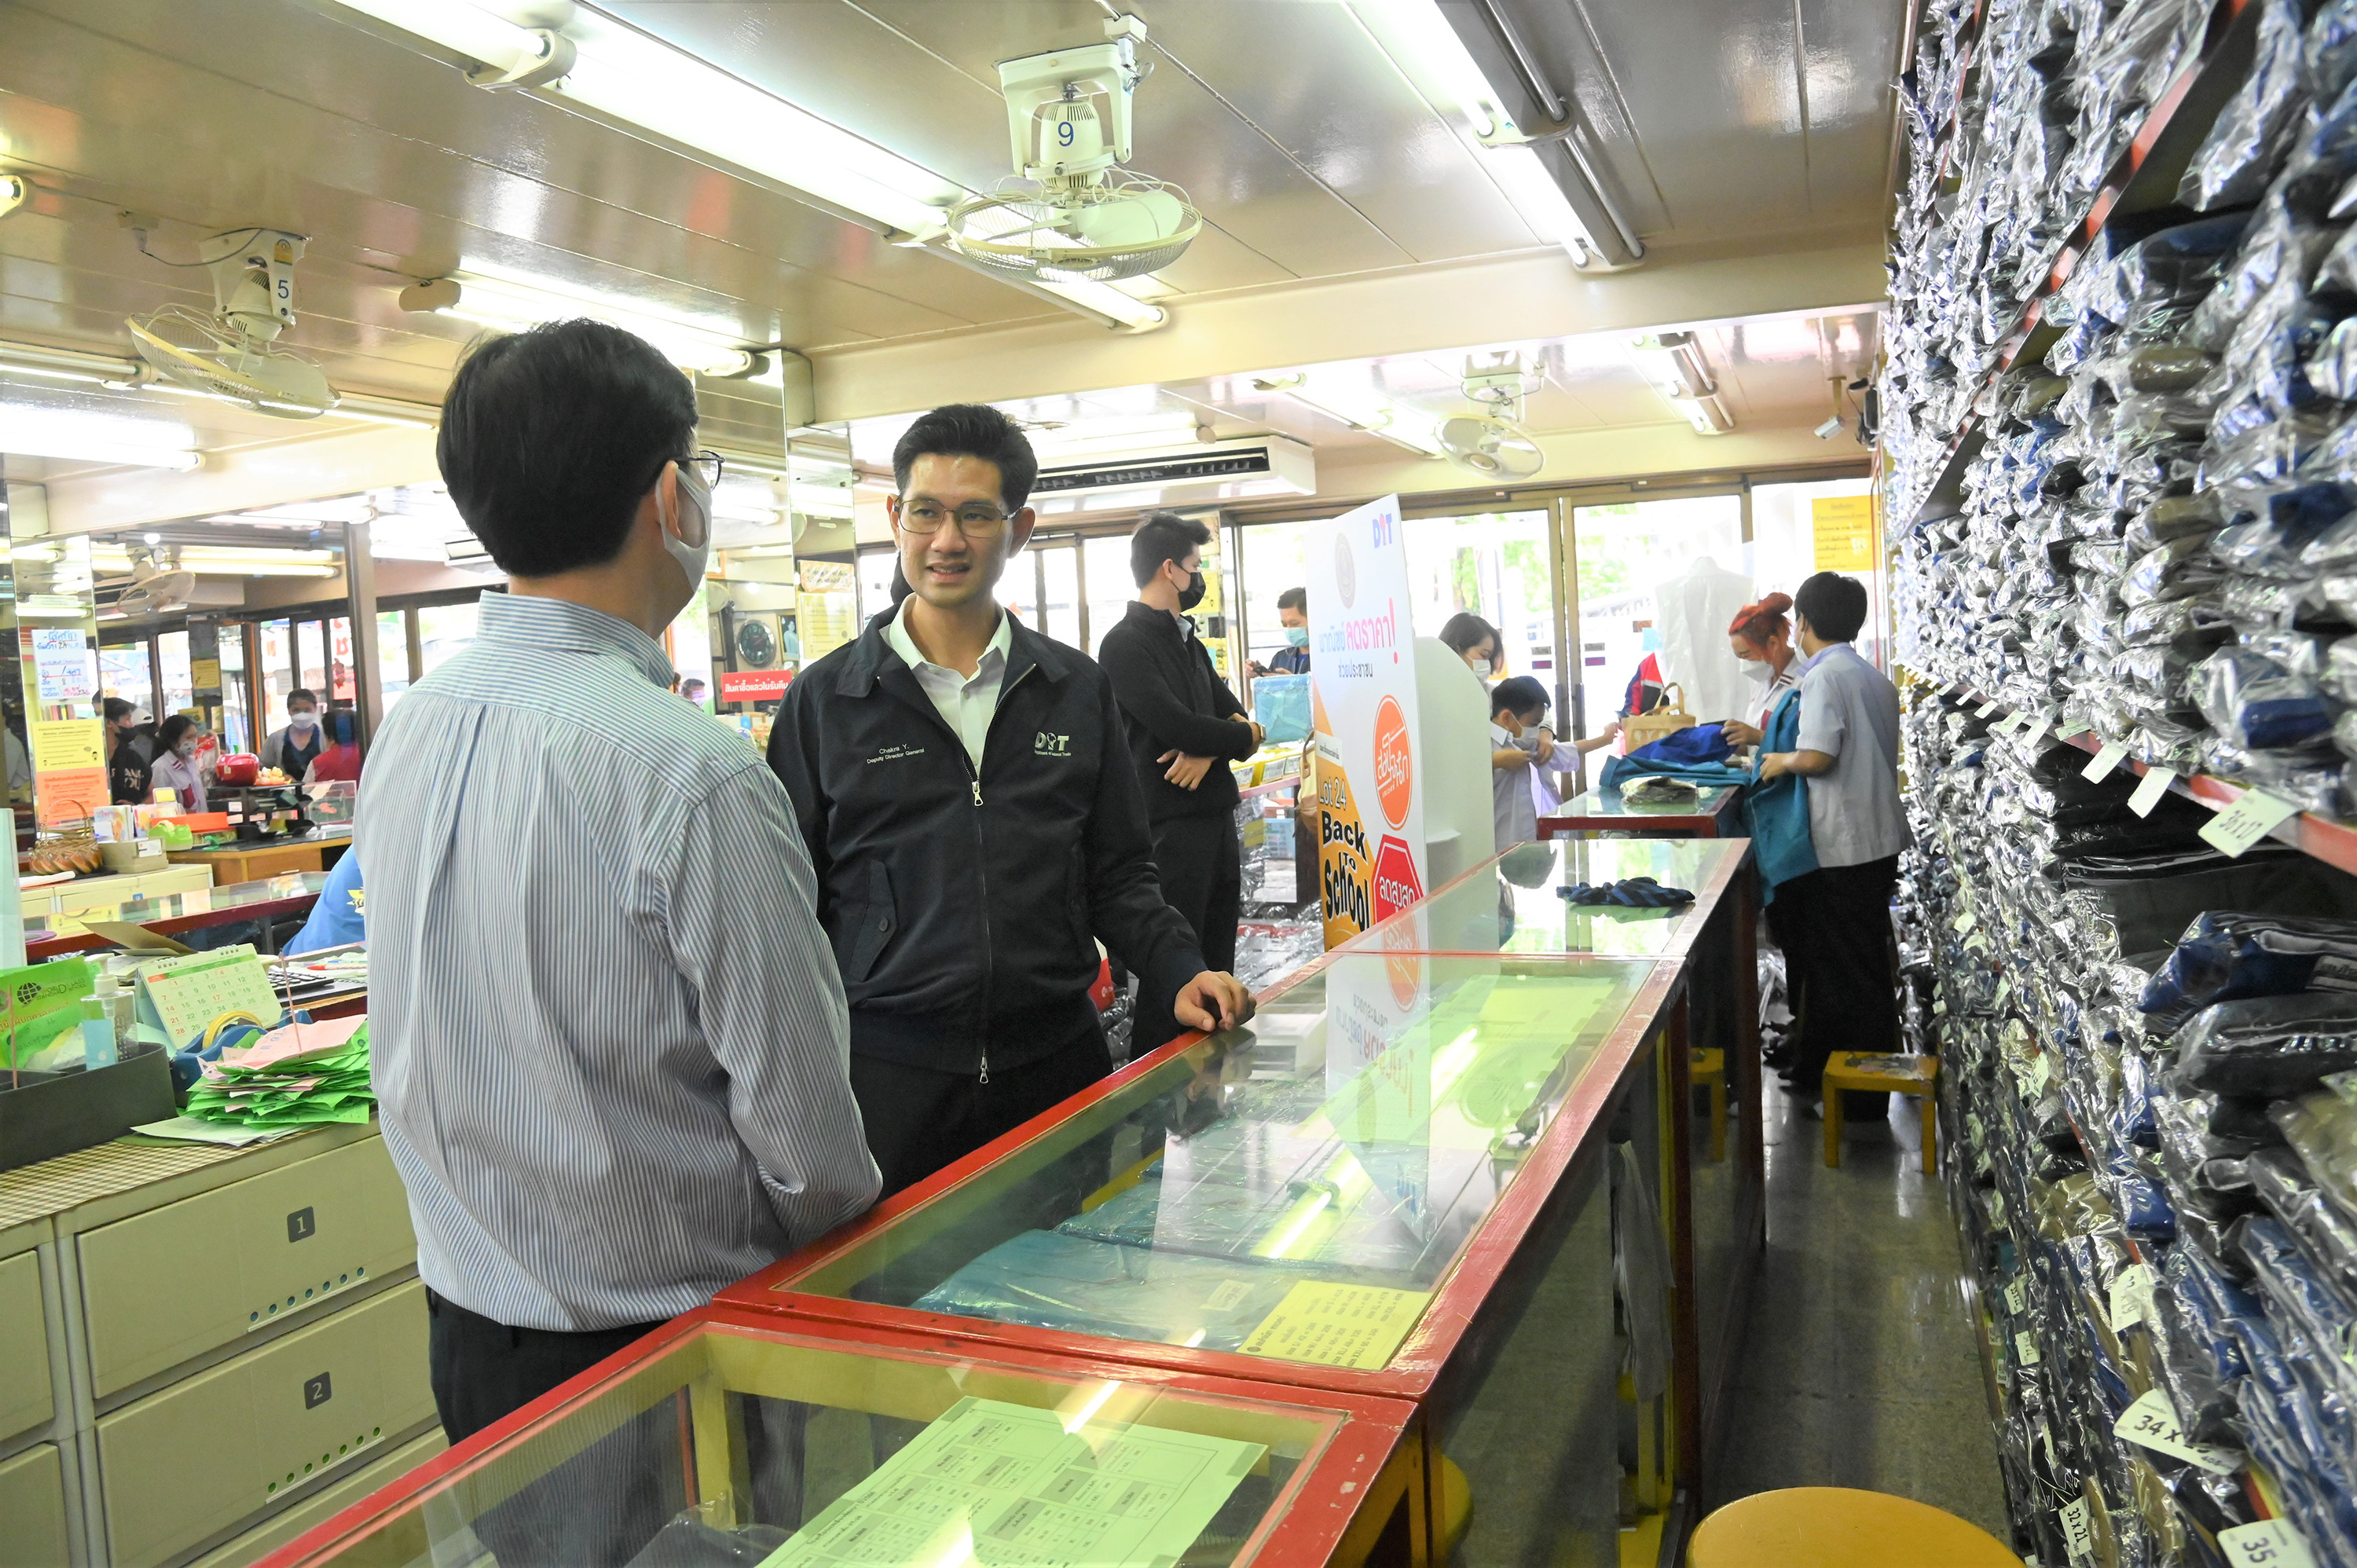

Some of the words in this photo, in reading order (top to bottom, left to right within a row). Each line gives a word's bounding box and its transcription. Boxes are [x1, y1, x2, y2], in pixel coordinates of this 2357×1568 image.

[1058, 122, 1074, 147] 9
[278, 280, 289, 299] 5
[1338, 658, 1373, 678] ช่วยประชาชน
[725, 678, 789, 692] สินค้าซื้อแล้วไม่รับคืน
[1319, 775, 1332, 807] Lot
[1334, 776, 1346, 811] 24
[1321, 810, 1368, 864] Back
[1380, 876, 1415, 913] ลดสูงสด
[297, 1216, 306, 1233] 1
[313, 1383, 323, 1400] 2
[2134, 1415, 2166, 1436] 34
[2164, 1429, 2182, 1442] x
[2068, 1508, 2080, 1522] 32
[2074, 1528, 2088, 1543] 21
[2242, 1537, 2278, 1563] 35
